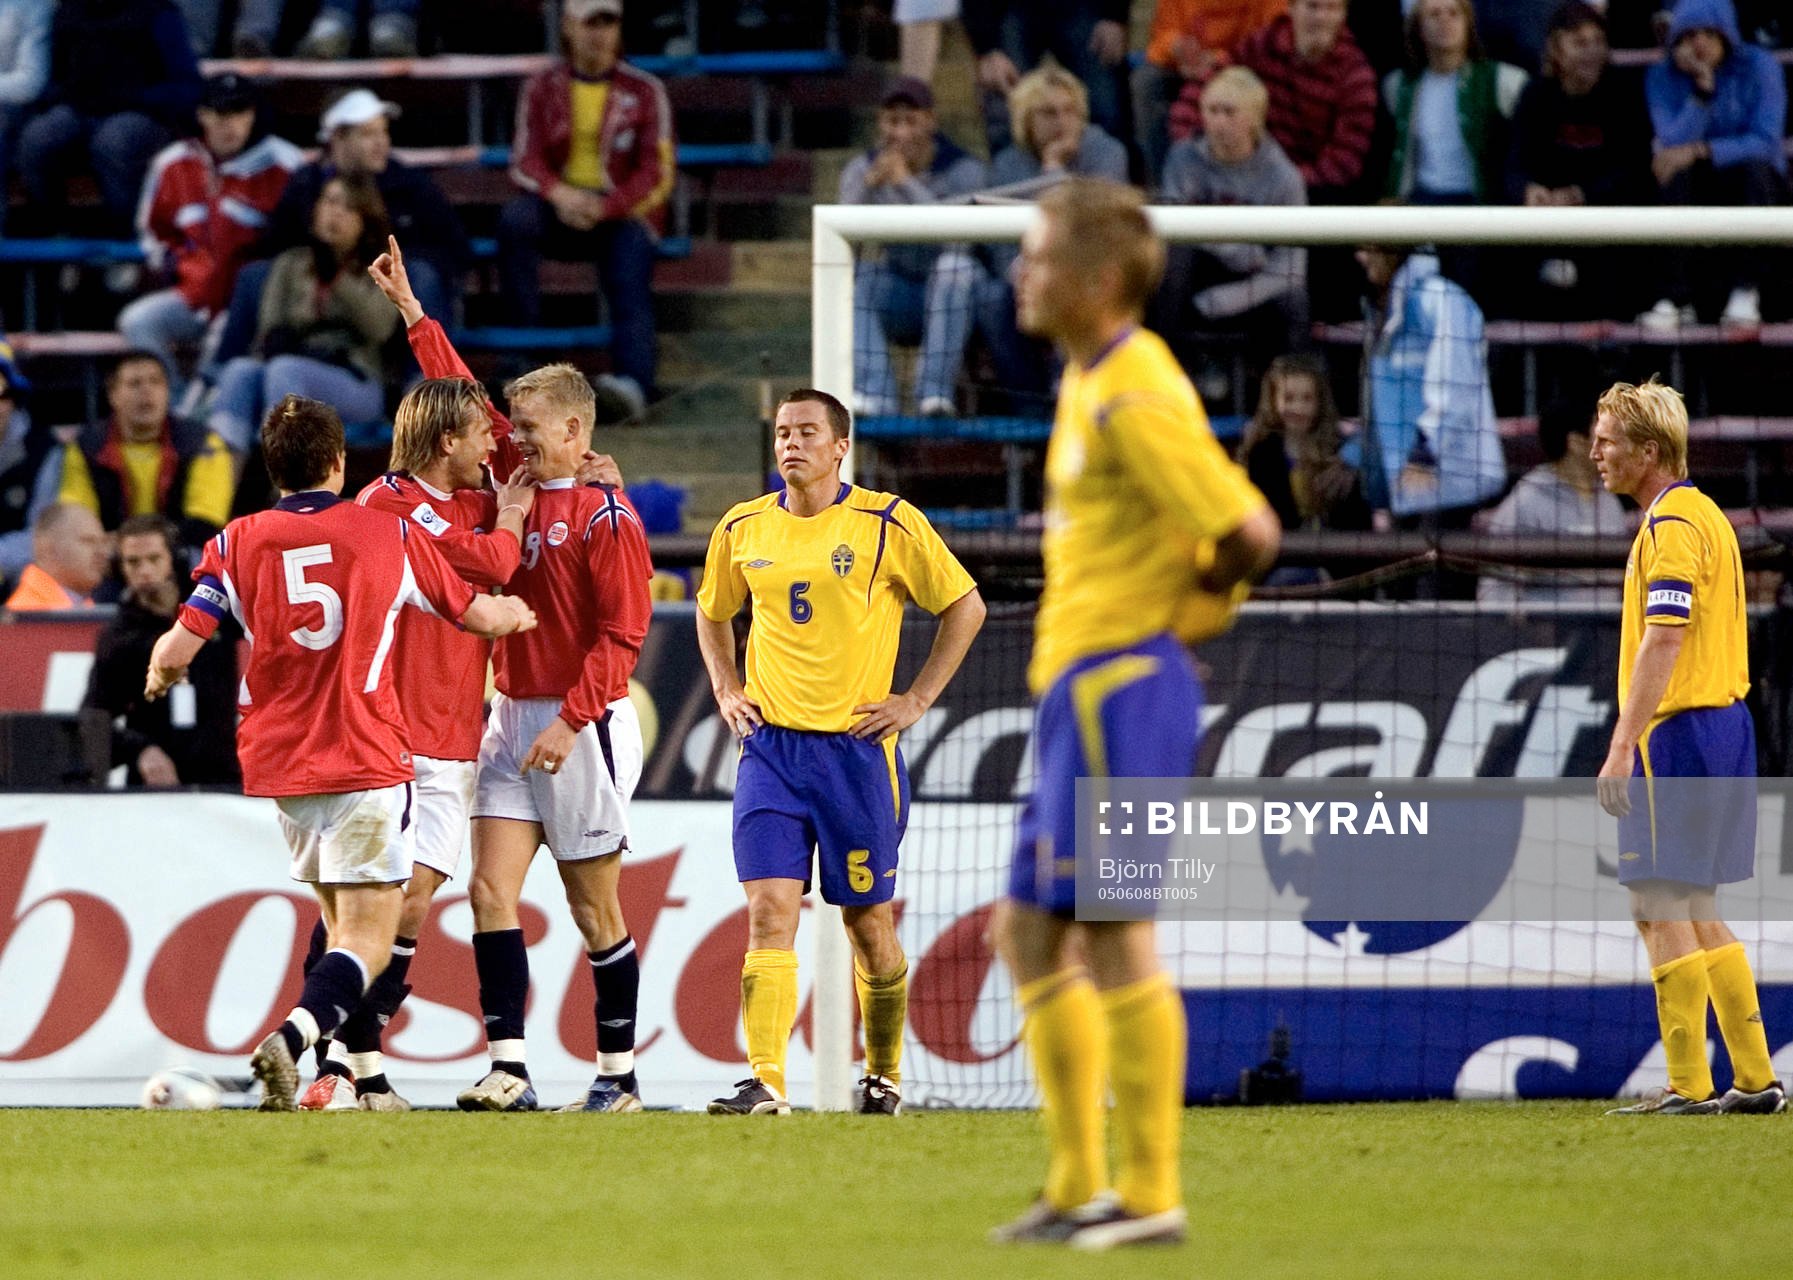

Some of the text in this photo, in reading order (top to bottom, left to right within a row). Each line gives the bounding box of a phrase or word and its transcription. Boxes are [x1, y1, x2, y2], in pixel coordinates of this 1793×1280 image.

[282, 543, 344, 651] 5
[789, 581, 813, 625] 6
[847, 849, 875, 894] 6
